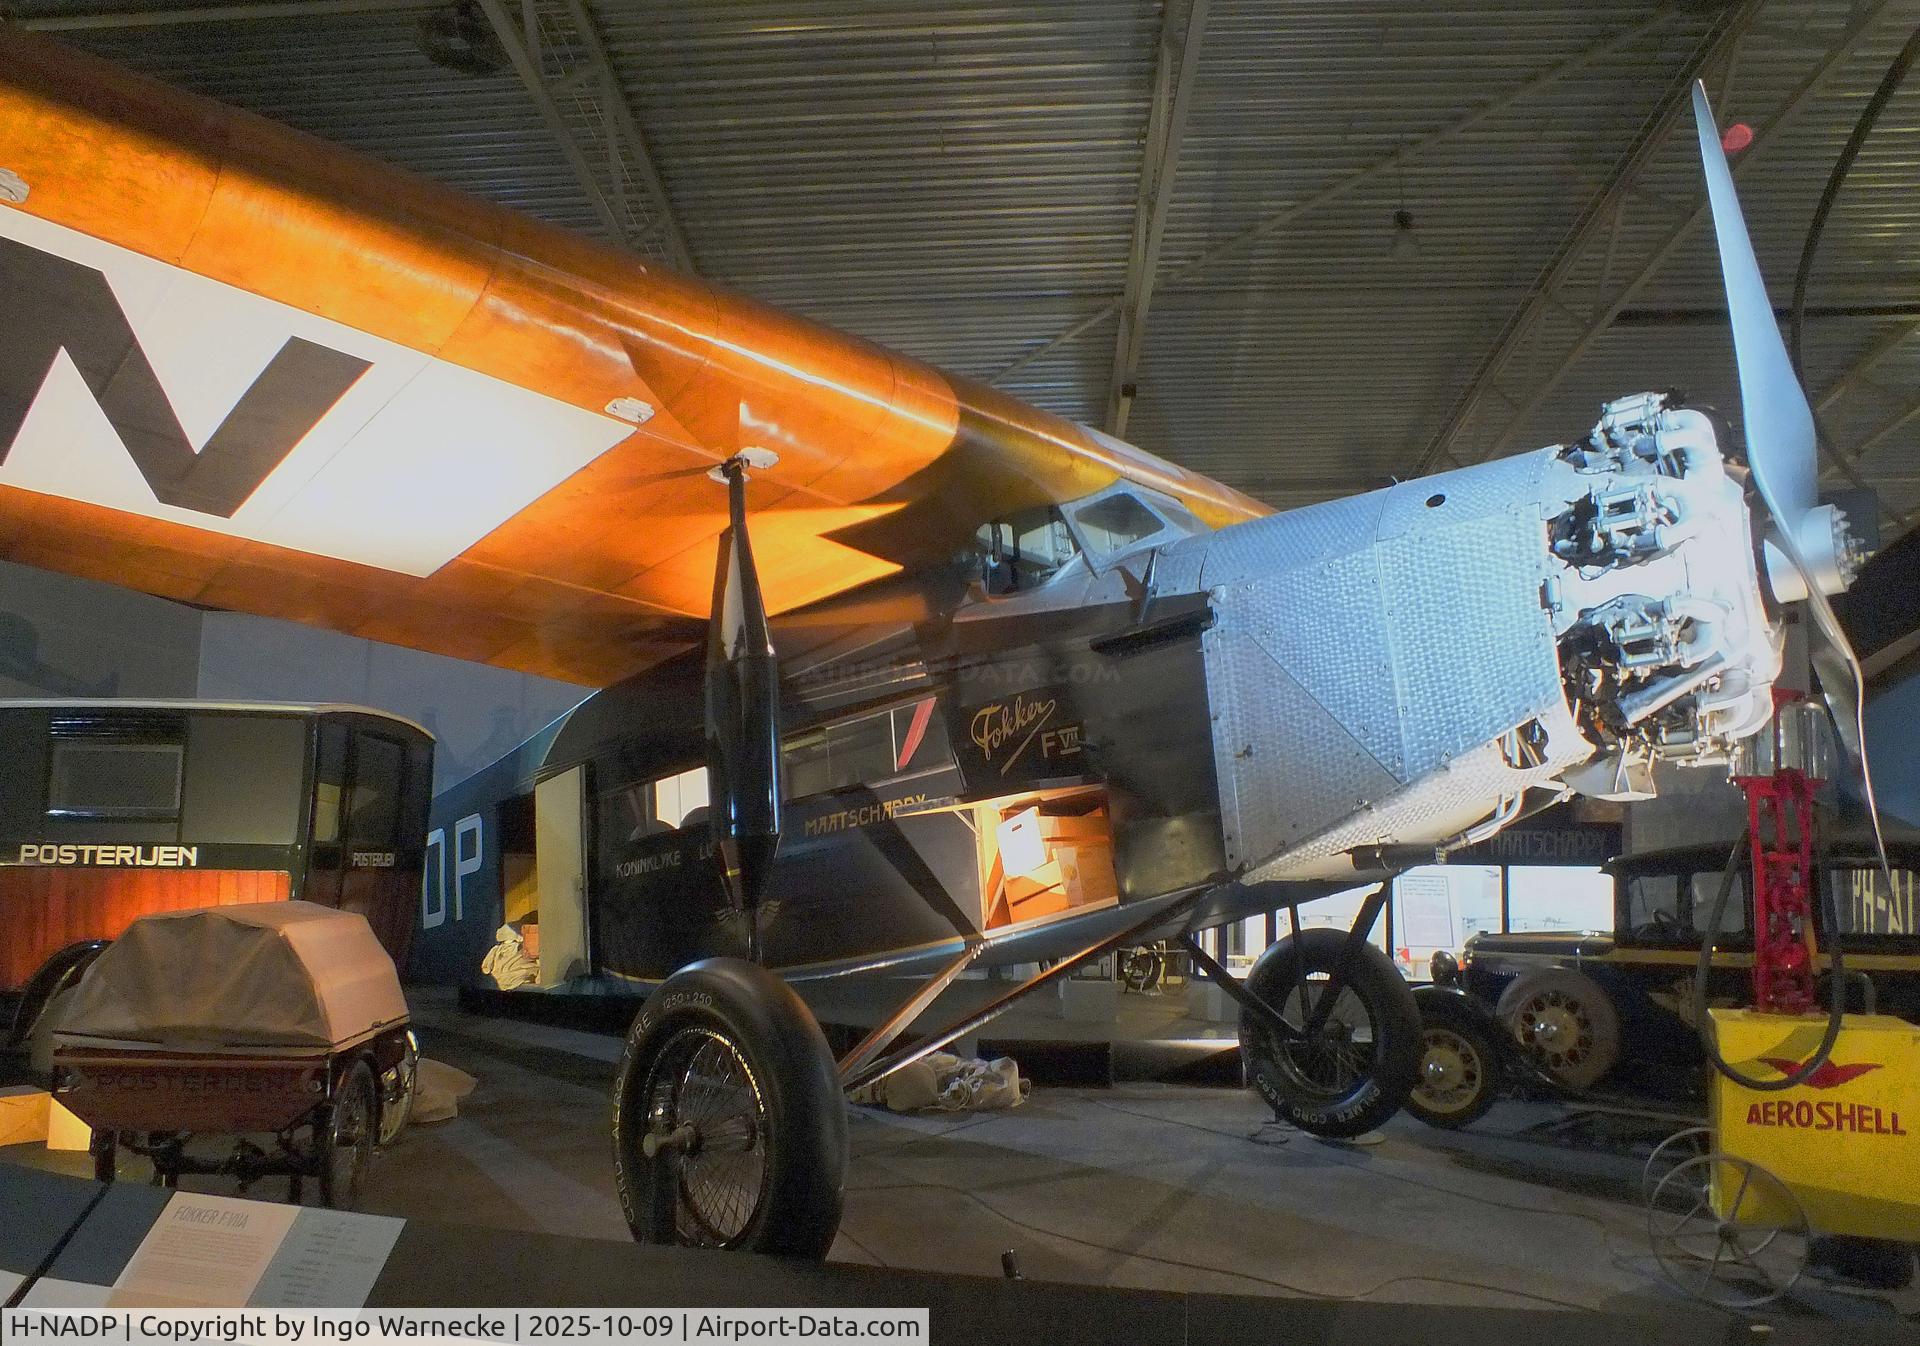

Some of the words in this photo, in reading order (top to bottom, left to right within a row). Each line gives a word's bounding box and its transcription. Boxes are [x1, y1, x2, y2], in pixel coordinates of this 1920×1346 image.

[970, 695, 1056, 776] Fokker
[20, 844, 197, 867] POSTERIJEN
[623, 1012, 651, 1059] TYRE
[1746, 1100, 1907, 1137] AEROSHELL
[172, 1205, 219, 1225] FOKKER
